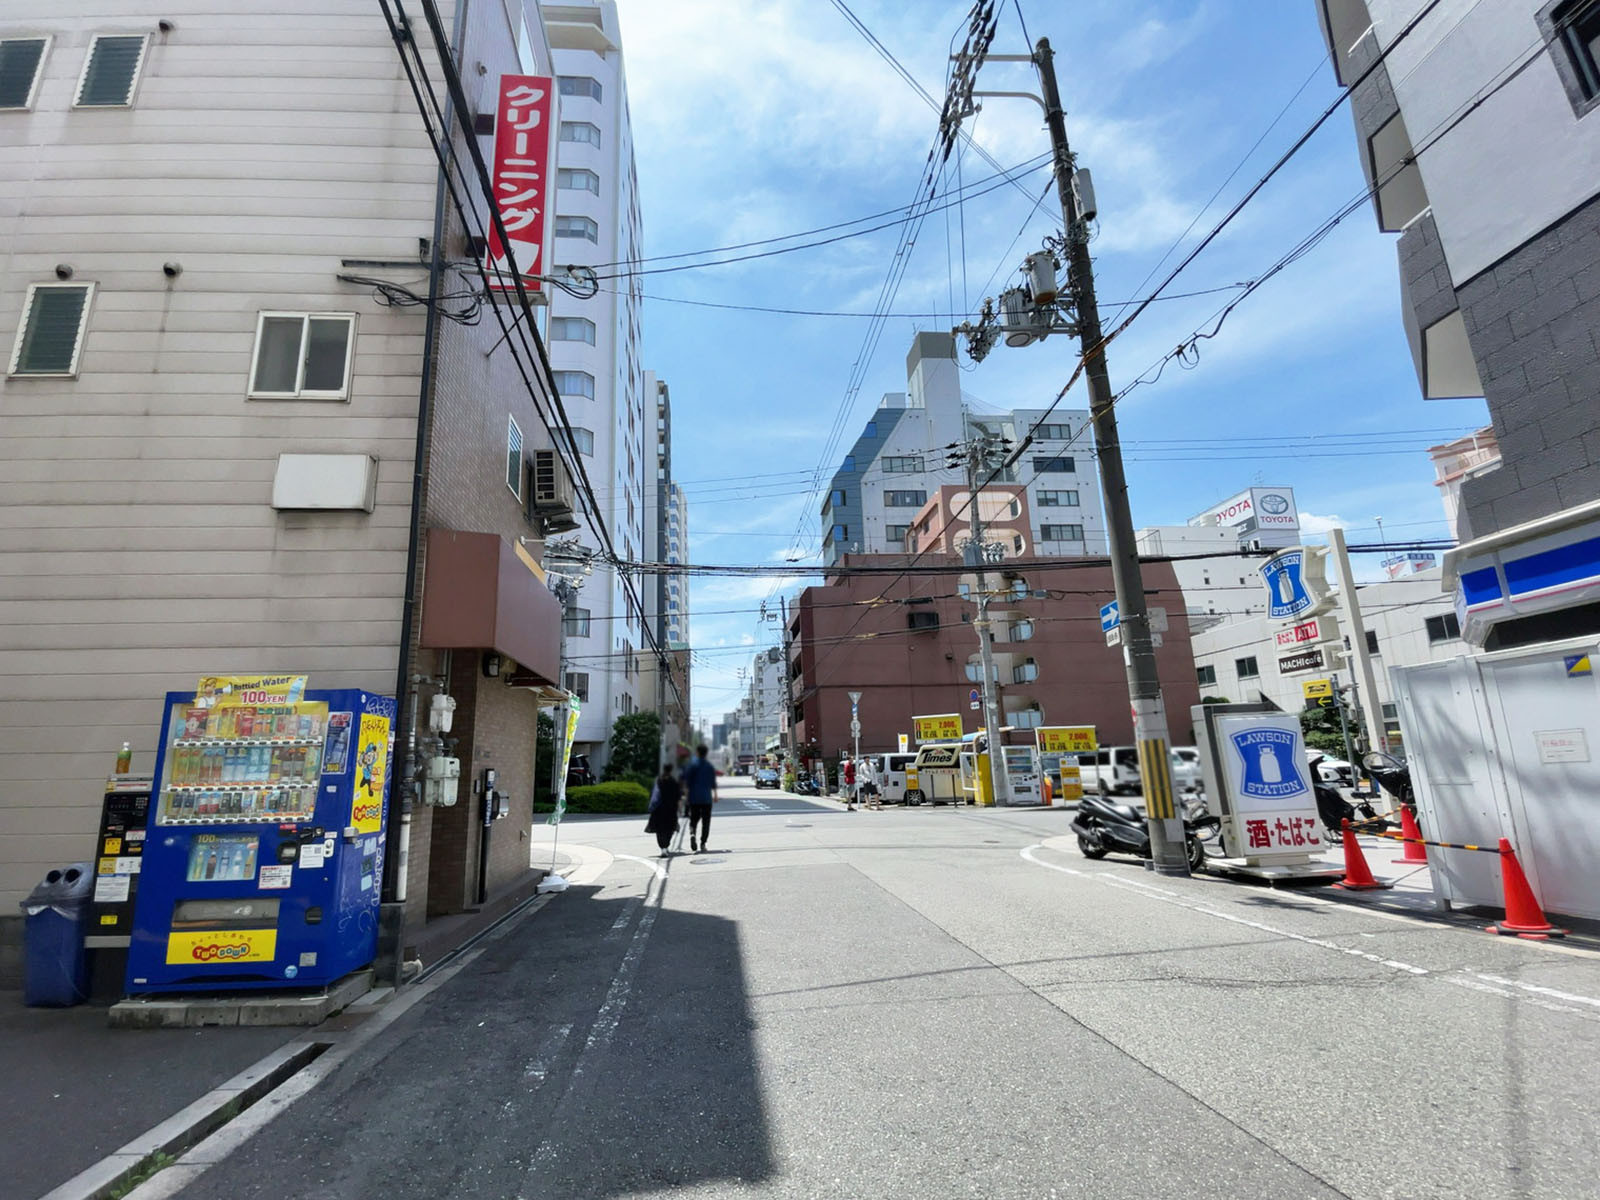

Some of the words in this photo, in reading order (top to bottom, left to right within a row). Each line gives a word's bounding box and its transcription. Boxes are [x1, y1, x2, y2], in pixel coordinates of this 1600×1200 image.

[499, 85, 544, 232] クリーニング
[1264, 554, 1300, 577] LAWSON
[1272, 596, 1309, 616] STATION
[1296, 624, 1316, 642] ATM
[1280, 657, 1305, 671] MACHI
[262, 676, 292, 687] Water
[1237, 732, 1291, 747] LAWSON
[922, 749, 955, 764] Times
[1247, 780, 1300, 795] STATION
[1246, 817, 1320, 849] 酒・たばこ
